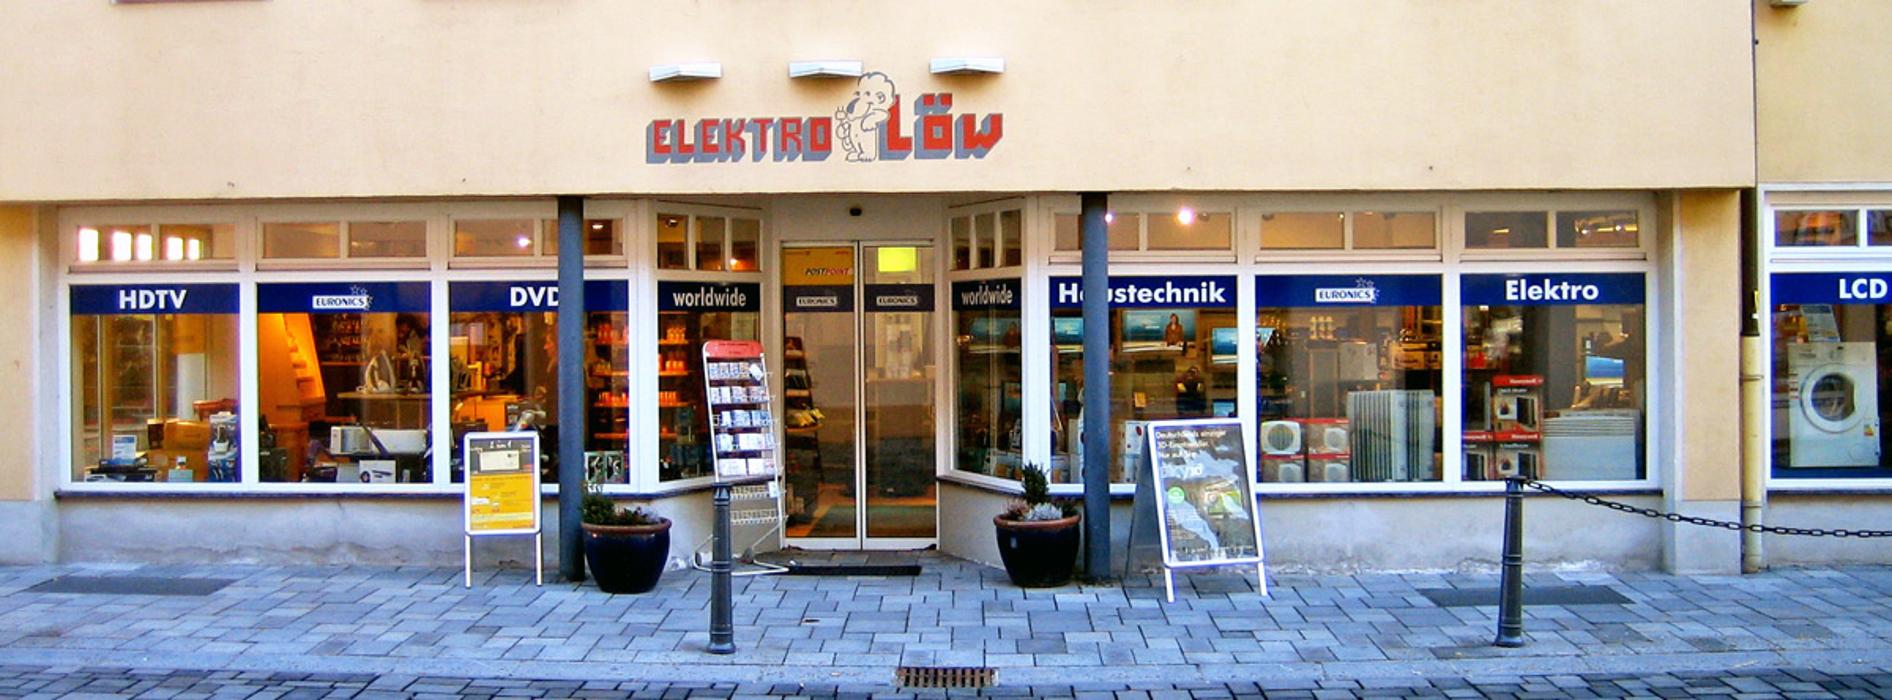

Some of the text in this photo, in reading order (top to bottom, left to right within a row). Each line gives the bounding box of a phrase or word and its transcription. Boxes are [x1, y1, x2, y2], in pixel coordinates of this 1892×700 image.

[646, 117, 832, 164] ELEKTRO
[805, 267, 850, 276] POSTPOINT
[119, 289, 187, 309] HDTV
[510, 286, 559, 307] DVD
[673, 286, 746, 307] worldwide
[961, 279, 1013, 304] worldwide
[1058, 281, 1226, 303] Hstechnik
[1318, 290, 1372, 300] EURONICS
[1506, 279, 1599, 301] Elektro
[1839, 279, 1888, 299] LCD
[315, 297, 366, 307] EURONICS
[798, 297, 836, 305] EURONICS
[878, 297, 917, 305] EURONICS
